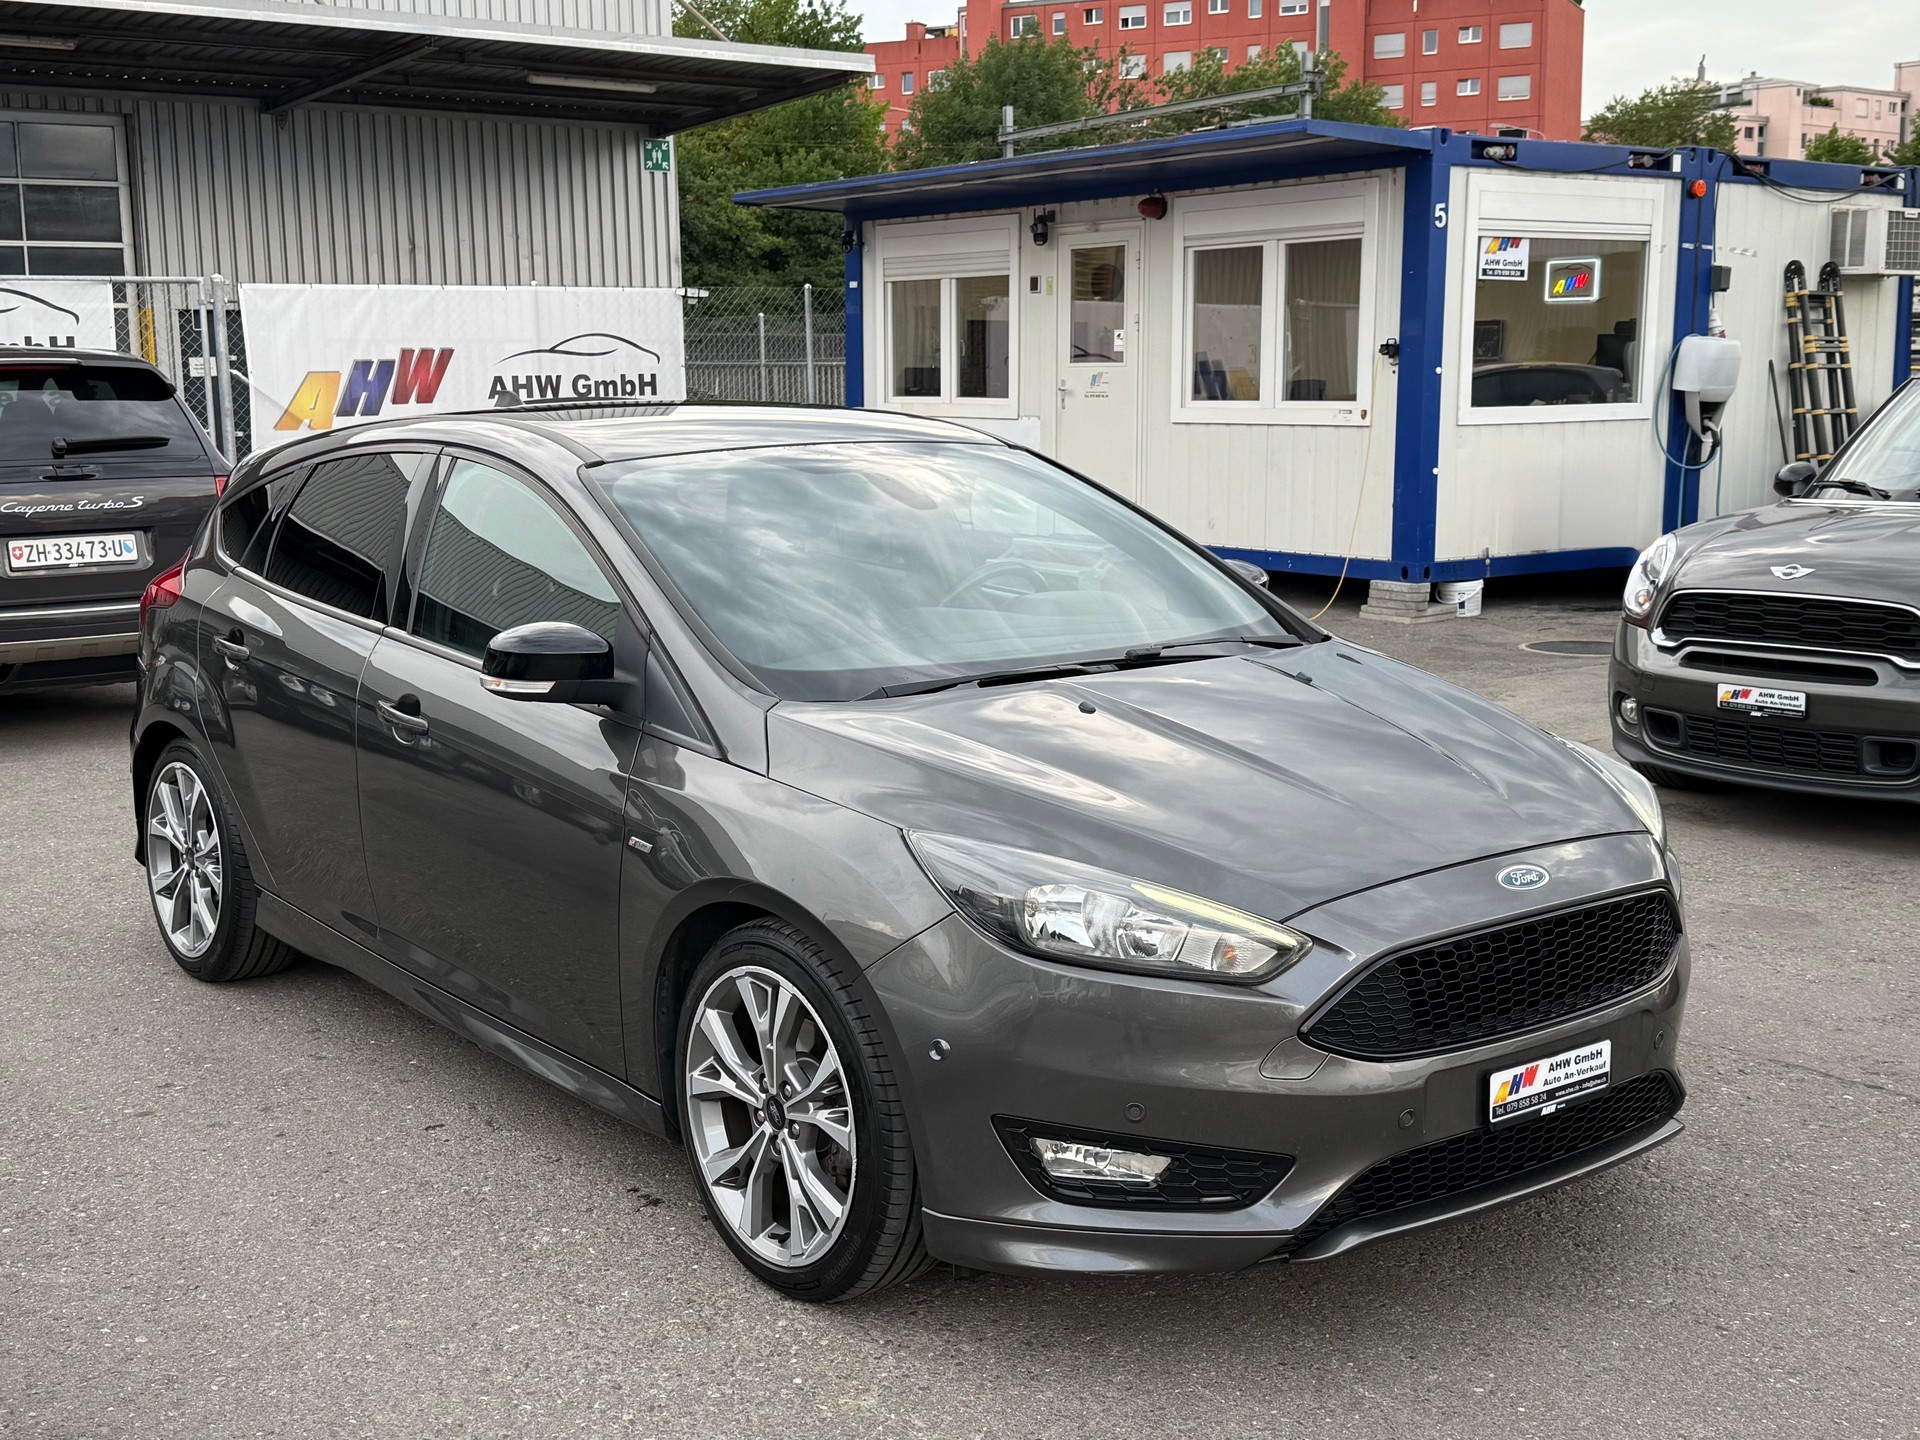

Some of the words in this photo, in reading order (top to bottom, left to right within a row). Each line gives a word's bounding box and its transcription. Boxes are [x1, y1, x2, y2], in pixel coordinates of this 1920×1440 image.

[1434, 202, 1447, 229] 5
[1484, 259, 1501, 267] AHW
[1502, 259, 1523, 268] GmbH
[1552, 272, 1590, 295] AHW
[273, 346, 456, 432] AHW
[487, 374, 562, 400] AHW
[571, 373, 658, 400] GmbH
[0, 501, 75, 518] Cayenne
[77, 499, 125, 511] turbo
[123, 495, 145, 509] S
[1720, 688, 1752, 700] AHW
[1510, 869, 1540, 886] Ford
[1548, 1057, 1571, 1073] AHW
[1574, 1048, 1603, 1065] GmbH
[1492, 1064, 1539, 1105] AHW
[1543, 1076, 1562, 1087] Auto
[1564, 1061, 1607, 1081] An-Verkauf
[1494, 1105, 1506, 1116] Tel.
[1506, 1101, 1518, 1112] 079
[1539, 1092, 1547, 1102] 24
